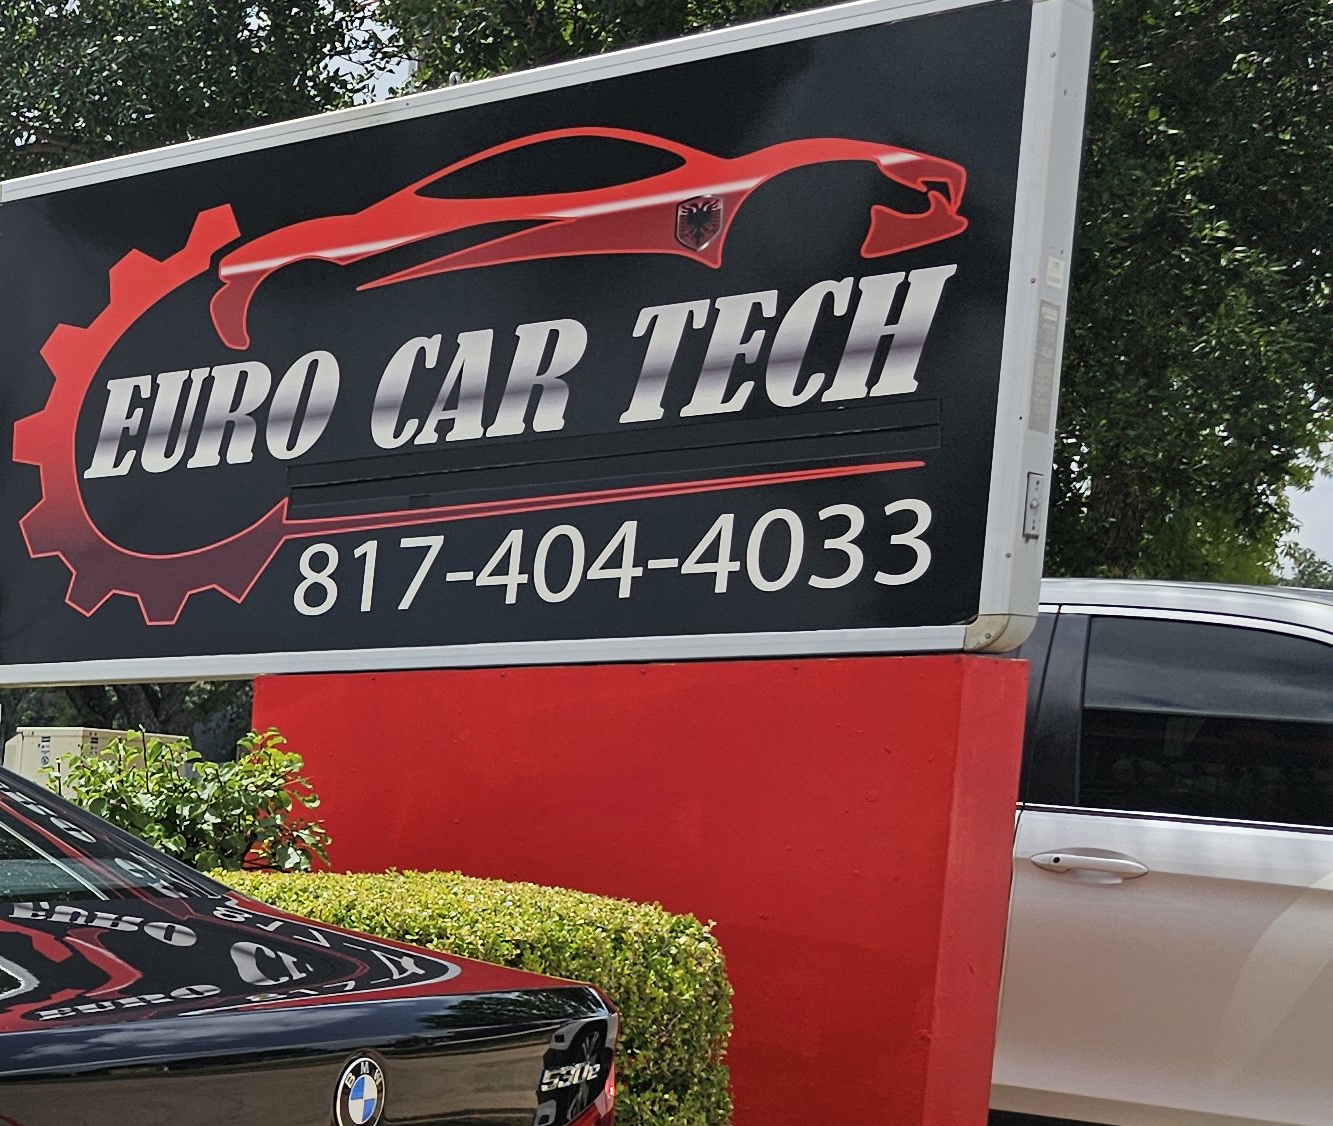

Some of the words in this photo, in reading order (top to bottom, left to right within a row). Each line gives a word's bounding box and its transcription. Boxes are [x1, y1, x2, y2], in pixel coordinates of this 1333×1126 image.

[84, 349, 340, 479] EURO
[371, 319, 588, 450] CAR
[619, 264, 958, 424] TECH
[293, 498, 933, 617] 817-404-4033
[344, 1061, 383, 1088] BMW
[540, 1062, 601, 1092] 530e
